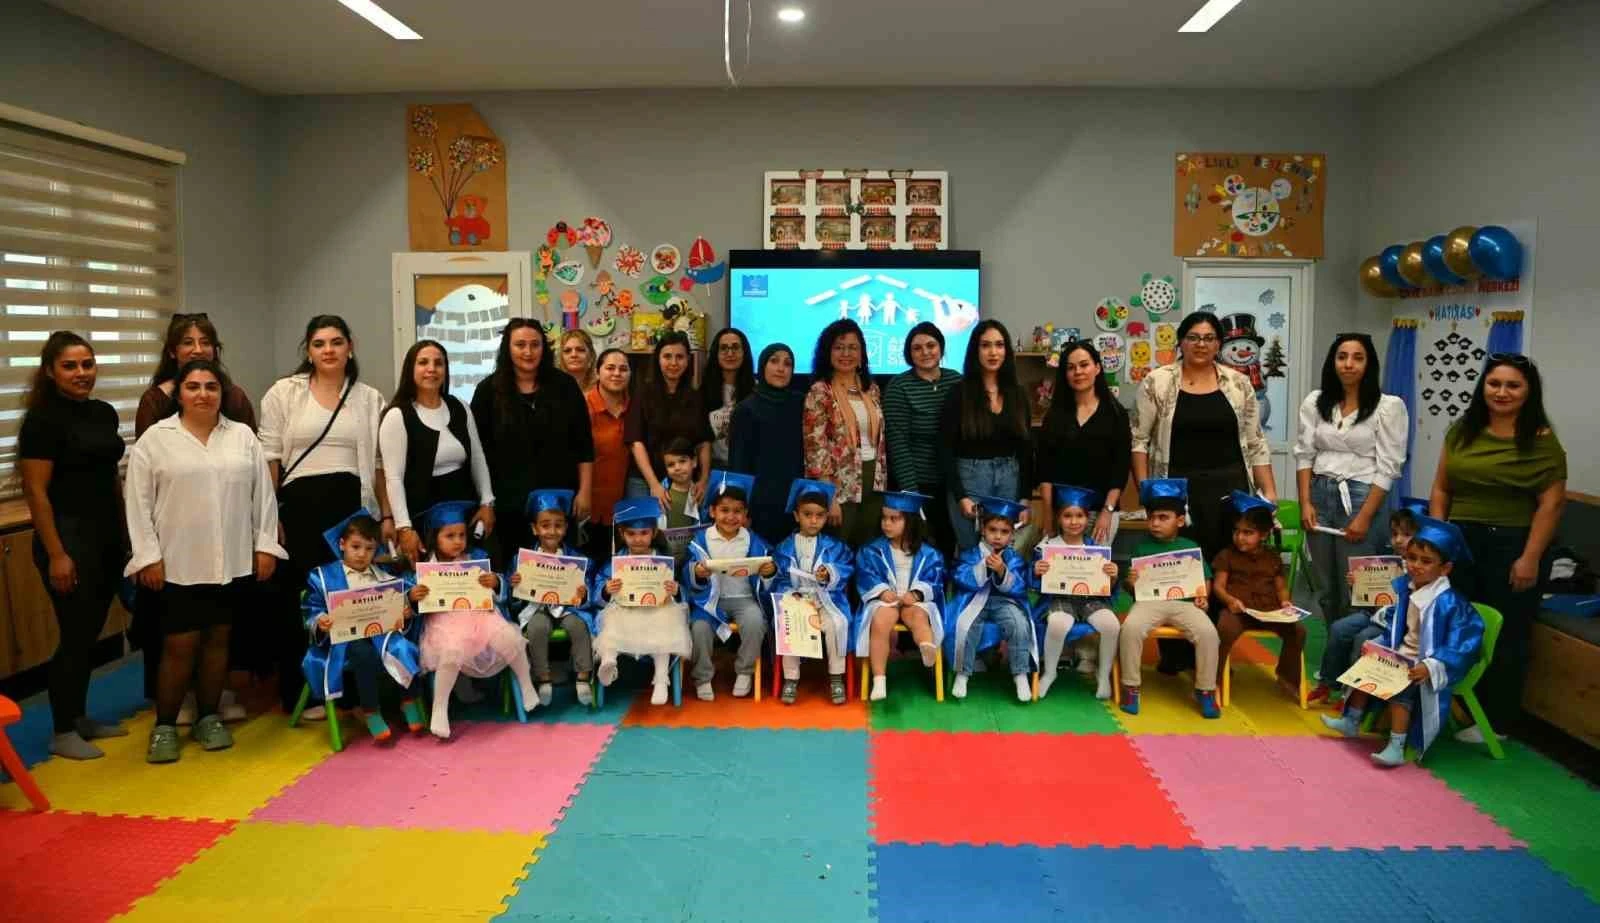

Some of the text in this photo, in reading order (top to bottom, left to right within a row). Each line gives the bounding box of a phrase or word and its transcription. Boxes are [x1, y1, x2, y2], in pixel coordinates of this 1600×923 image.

[536, 563, 565, 571] KATILIM
[1152, 560, 1182, 569] KATILIM
[351, 594, 383, 605] KATILIM
